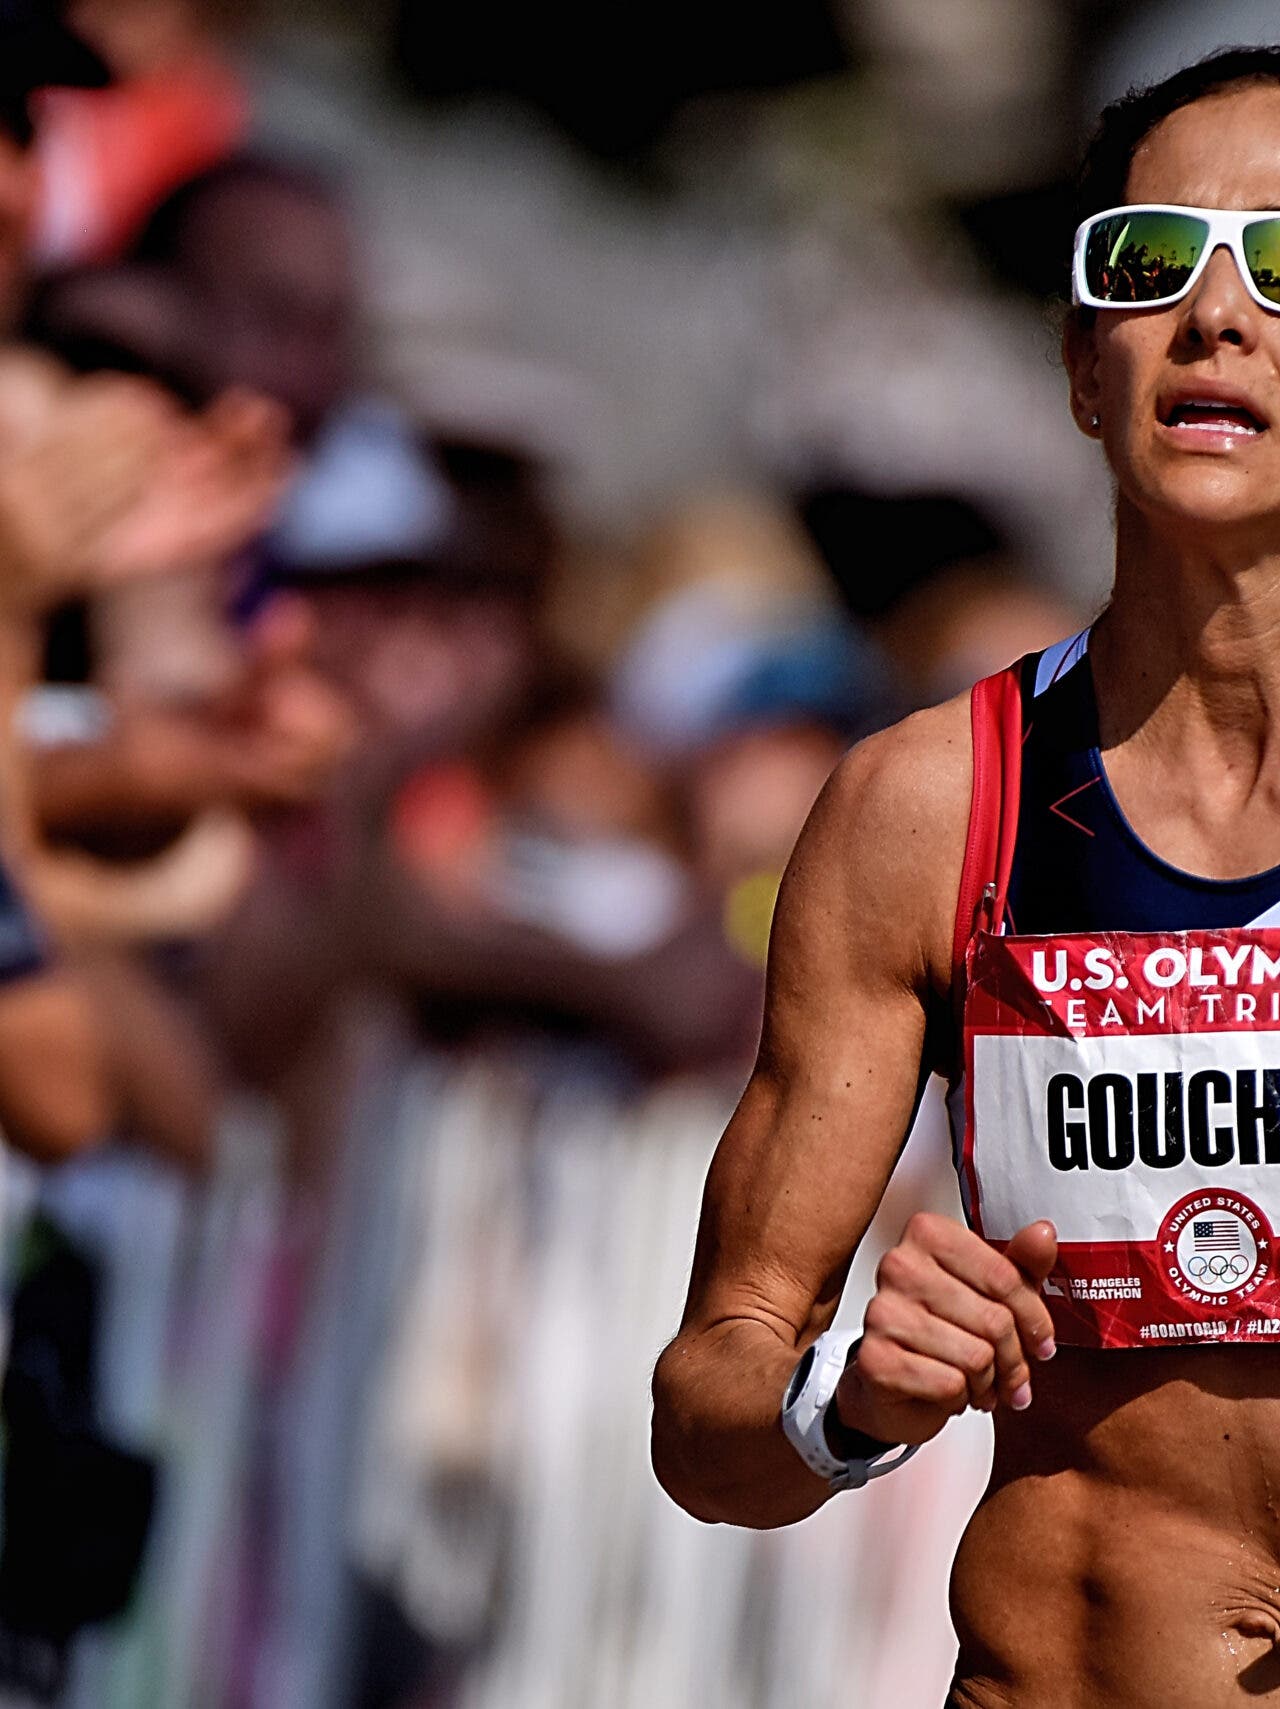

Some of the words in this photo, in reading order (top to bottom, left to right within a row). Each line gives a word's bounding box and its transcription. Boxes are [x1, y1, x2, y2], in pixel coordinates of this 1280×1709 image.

[1032, 947, 1129, 993] U.S.
[1038, 995, 1165, 1028] TEAM
[1169, 1197, 1212, 1232] UNITED
[1216, 1197, 1261, 1230] STATES
[1069, 1278, 1088, 1288] LOS
[1091, 1277, 1141, 1288] ANGELES
[1071, 1288, 1142, 1300] MARATHON
[1168, 1267, 1229, 1305] OLYMPIC
[1236, 1263, 1269, 1299] TEAM
